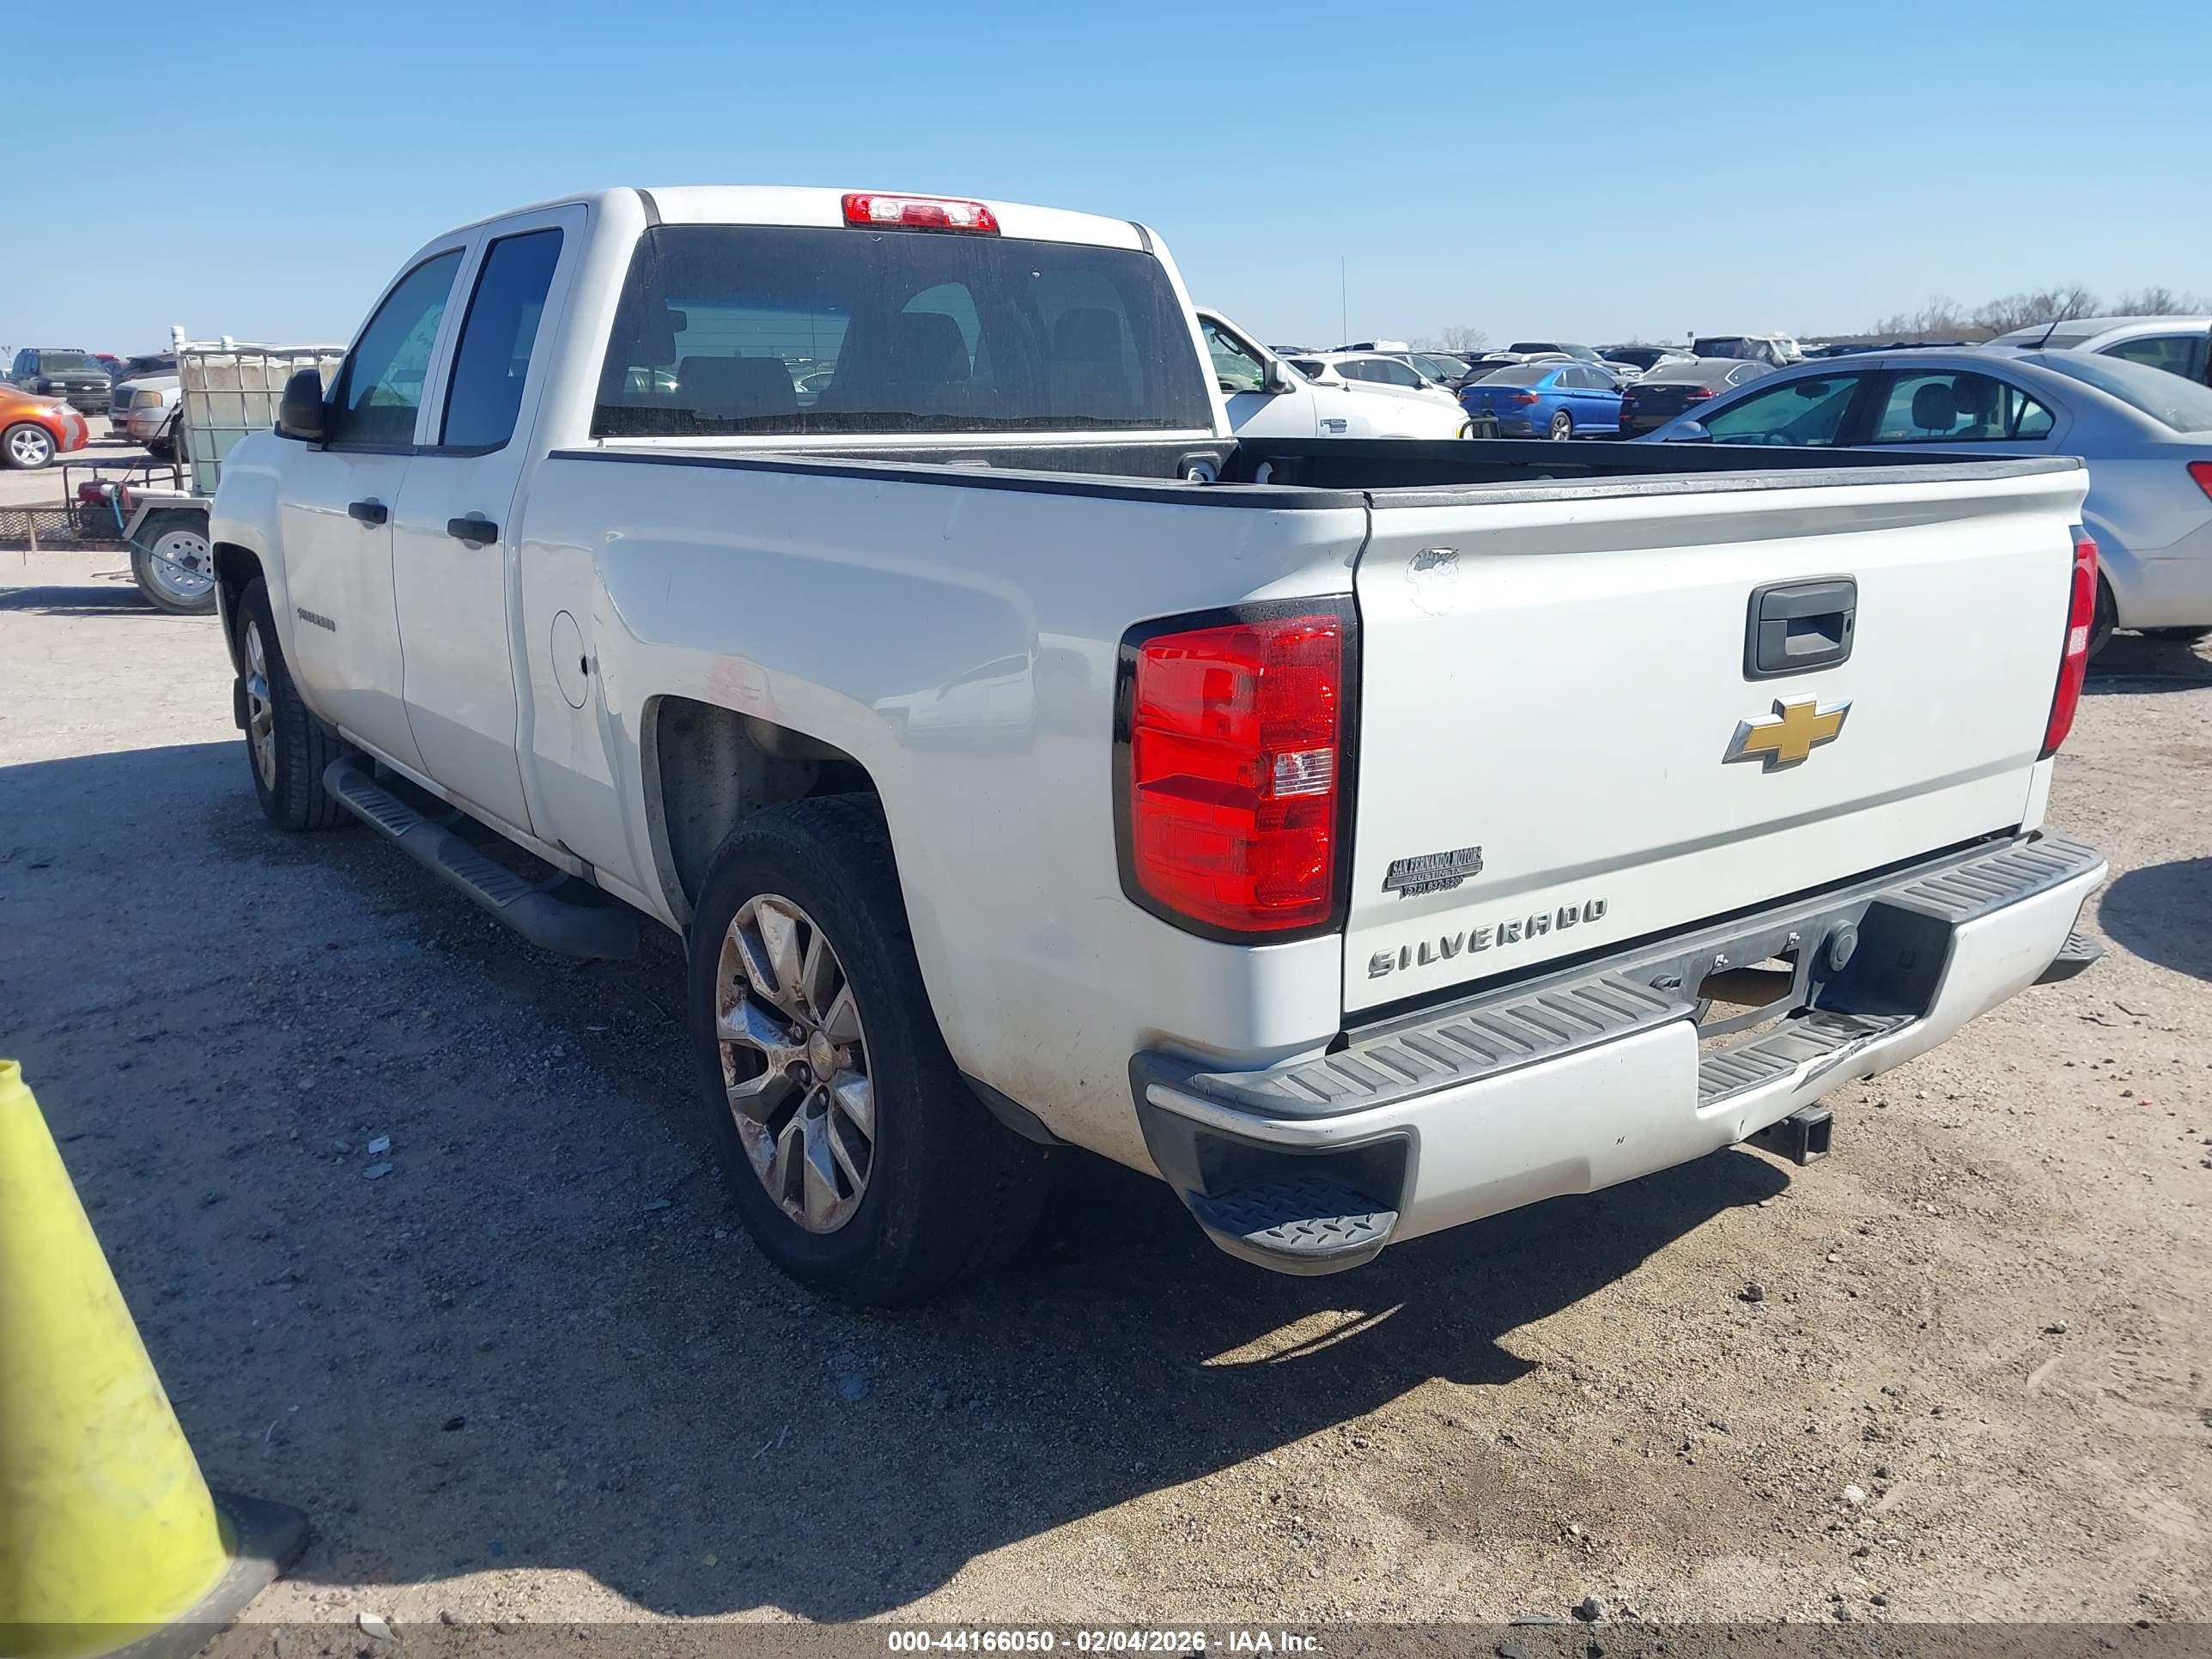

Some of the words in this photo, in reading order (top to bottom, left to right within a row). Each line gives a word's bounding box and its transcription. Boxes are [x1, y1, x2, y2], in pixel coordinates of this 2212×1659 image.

[1392, 860, 1411, 876] SAN
[1410, 853, 1451, 872] FERNANDO
[1451, 848, 1482, 866] MOTORS
[1411, 871, 1446, 881] AUSTIN
[1403, 883, 1426, 895] (512)
[1368, 898, 1607, 979] SILVERADO
